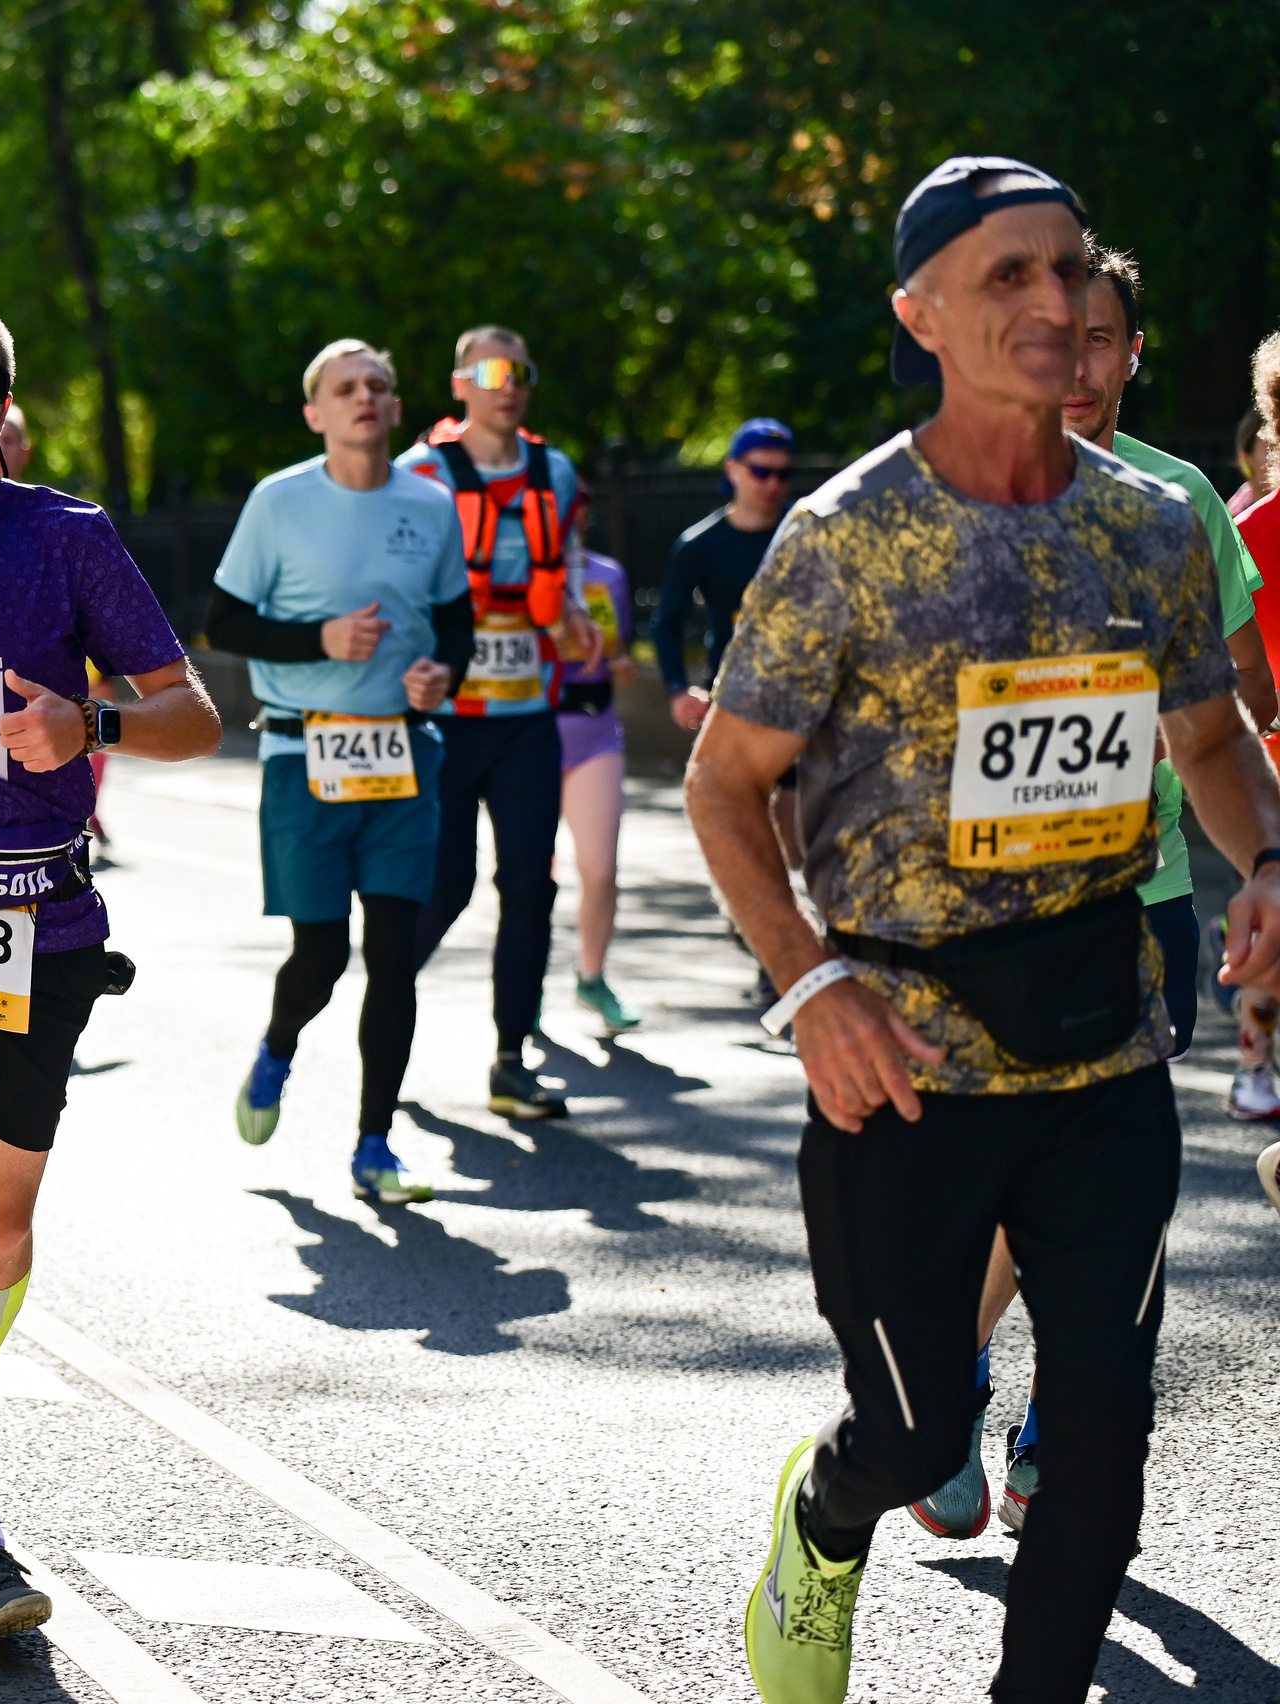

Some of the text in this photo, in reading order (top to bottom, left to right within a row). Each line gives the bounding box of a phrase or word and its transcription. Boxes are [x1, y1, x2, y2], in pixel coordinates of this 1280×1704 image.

[313, 730, 404, 761] 12416
[980, 711, 1130, 780] 8734
[1012, 780, 1098, 804] ГЕРЕЙХАН
[970, 822, 998, 858] H
